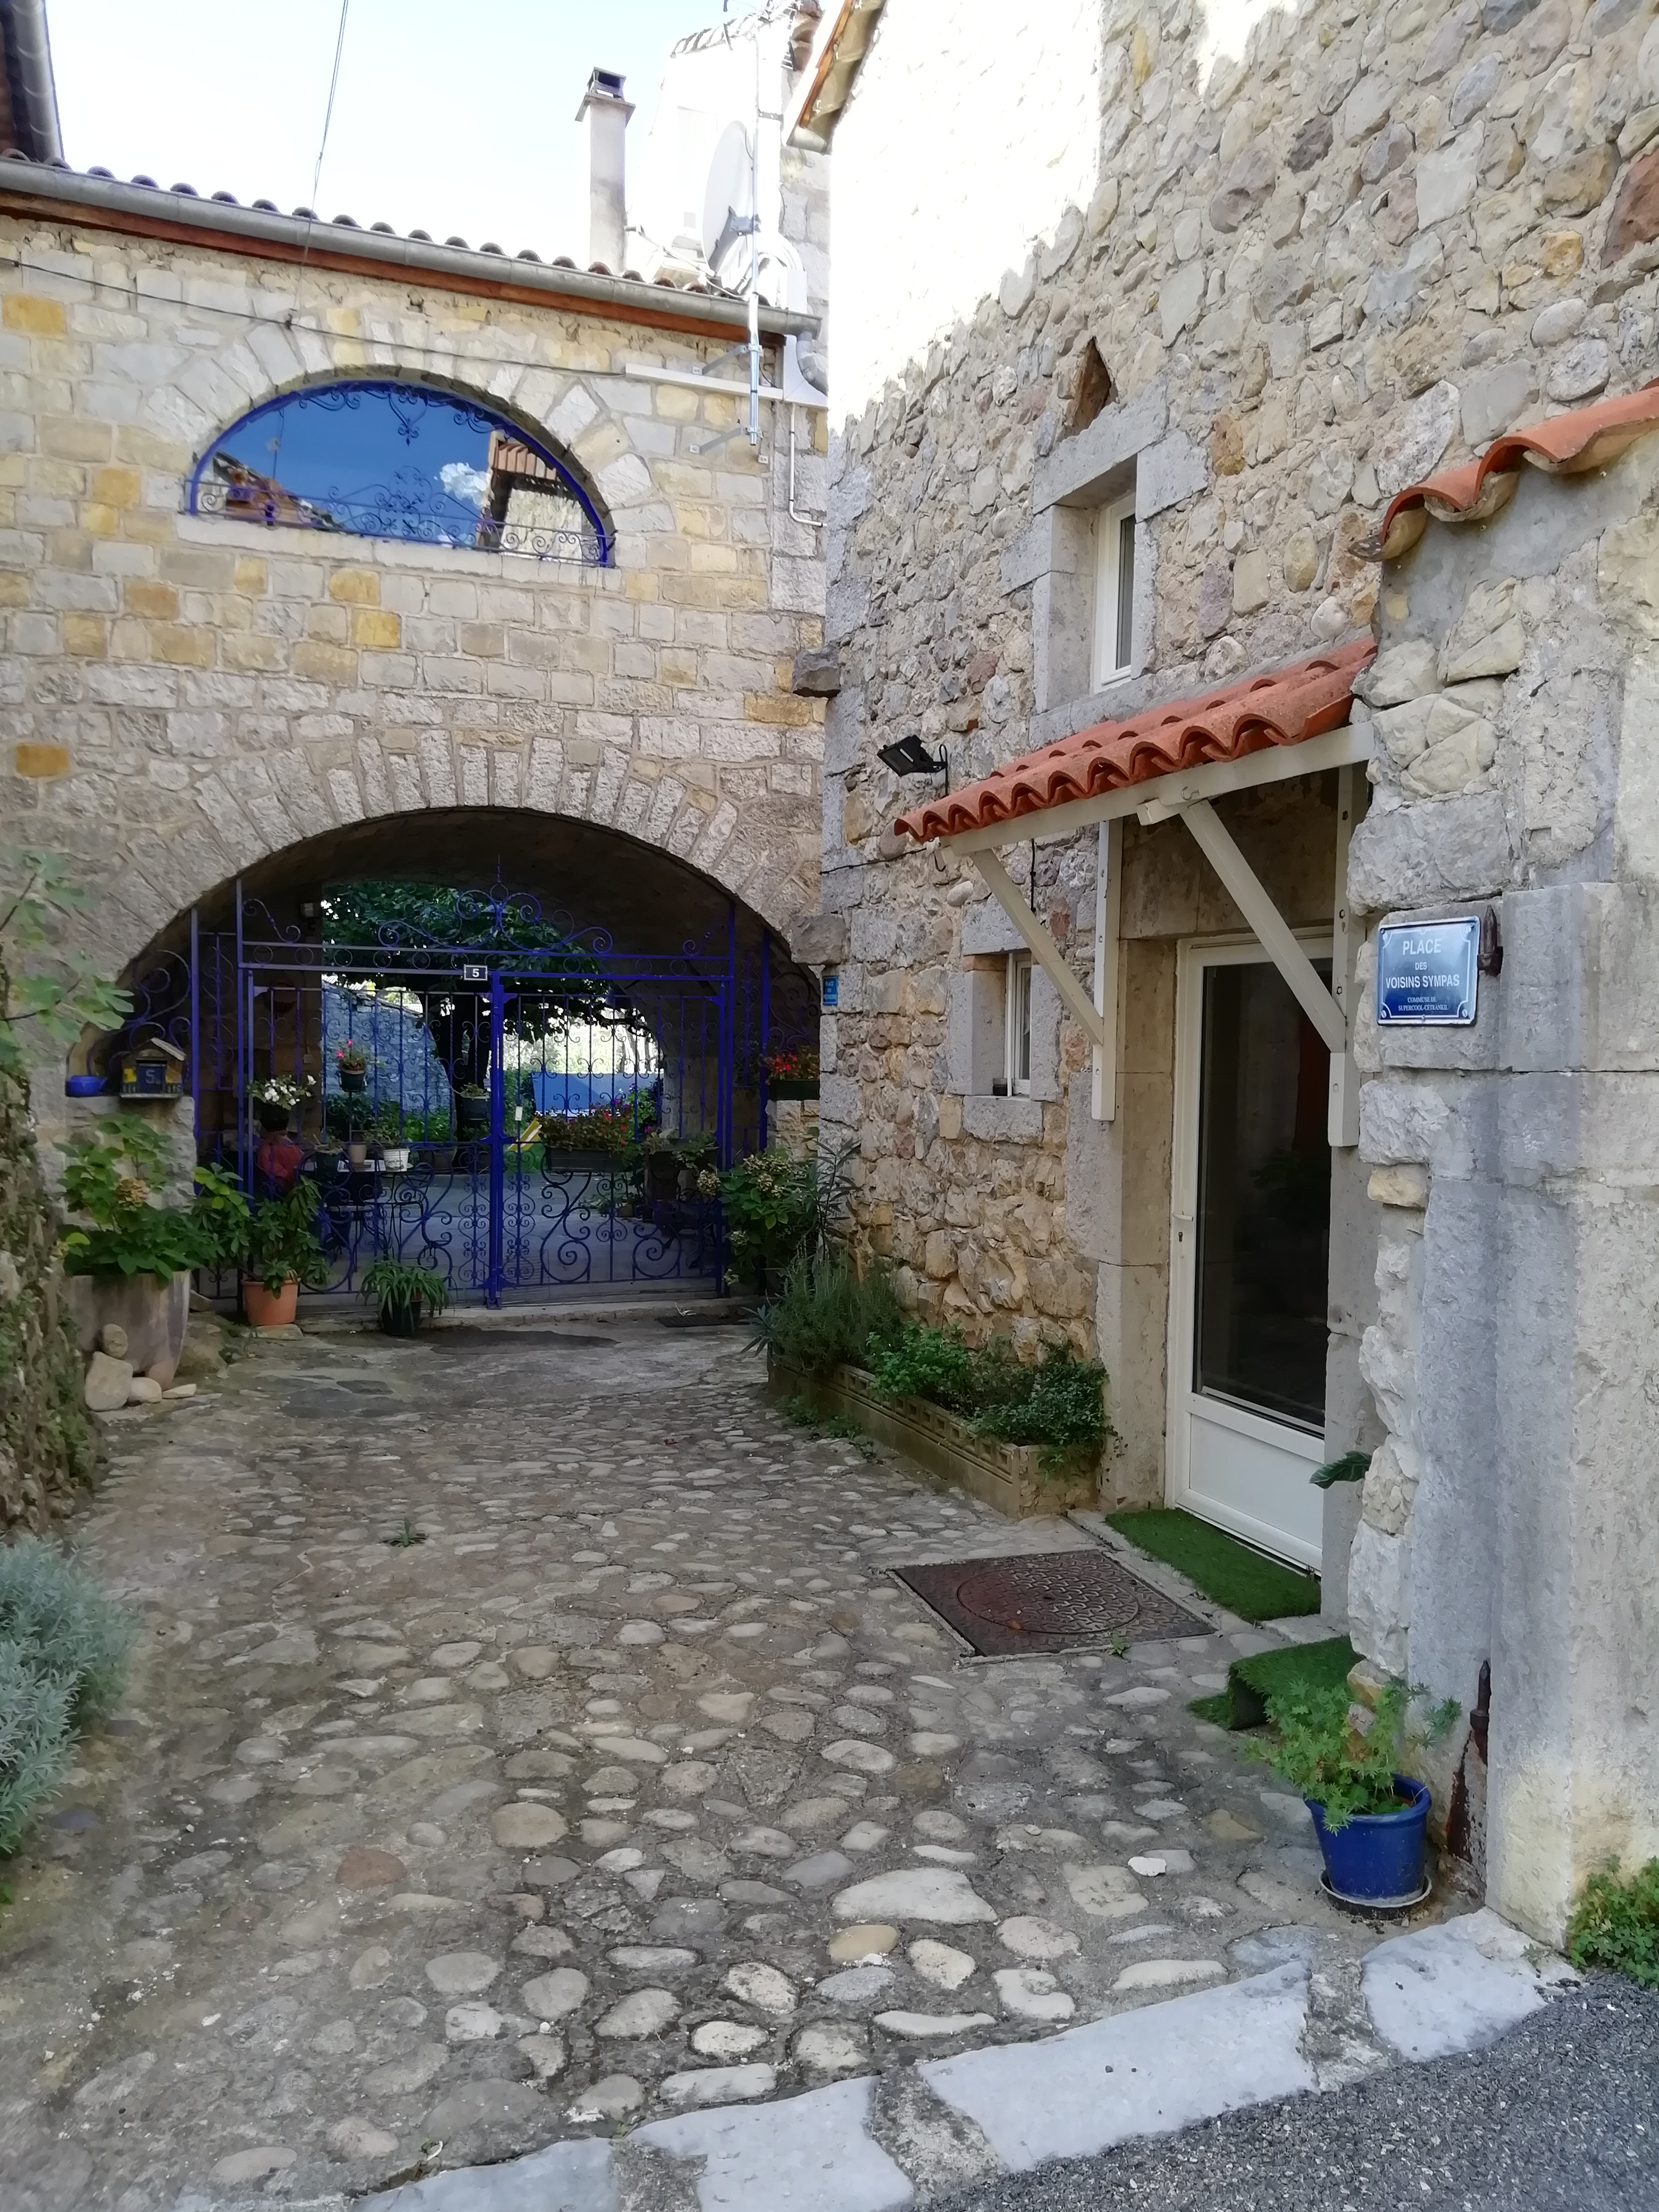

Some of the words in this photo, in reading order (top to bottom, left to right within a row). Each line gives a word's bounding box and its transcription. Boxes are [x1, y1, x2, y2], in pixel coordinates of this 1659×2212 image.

[1402, 939, 1442, 955] PLACE
[1415, 961, 1427, 970] DES
[472, 968, 480, 978] 5
[1386, 976, 1420, 988] VOISINS
[1422, 974, 1460, 987] SYMPAS
